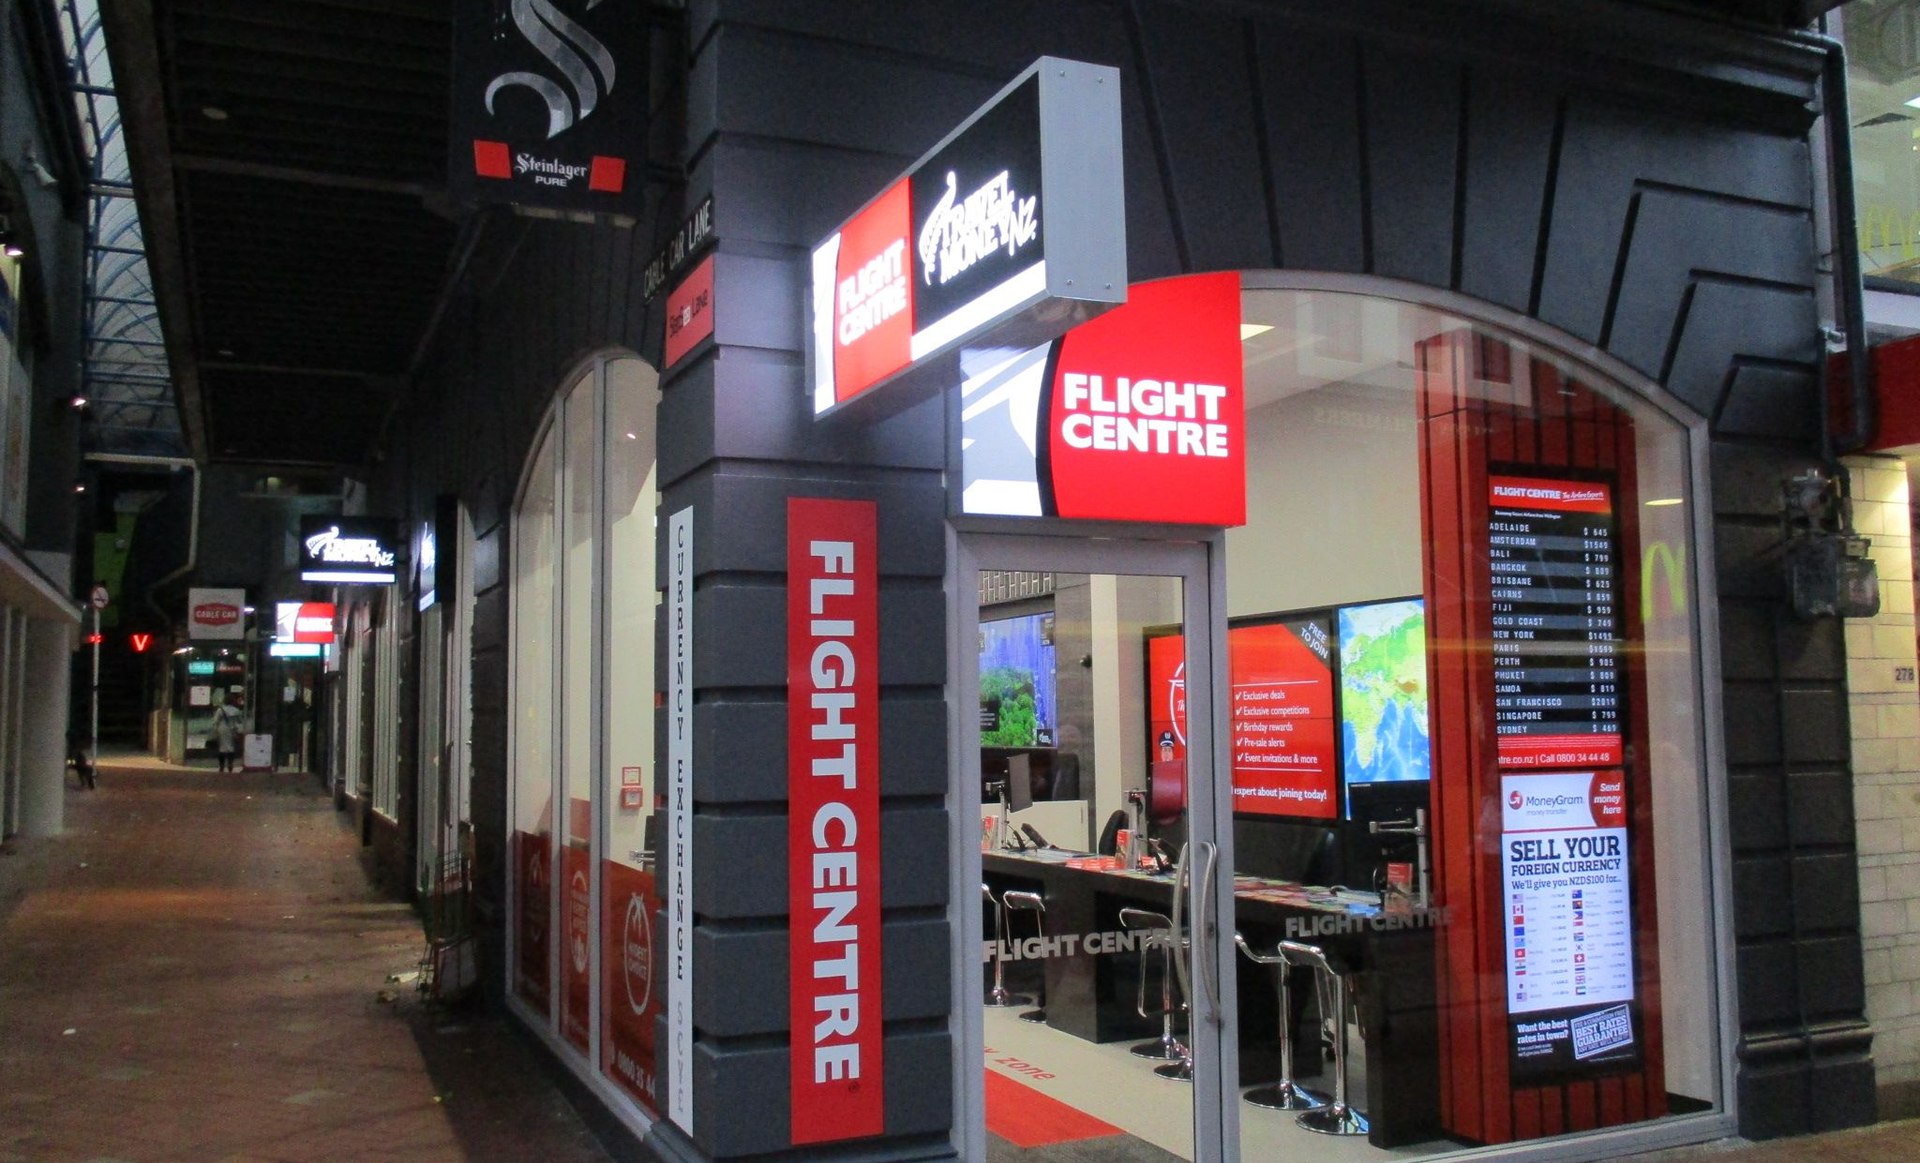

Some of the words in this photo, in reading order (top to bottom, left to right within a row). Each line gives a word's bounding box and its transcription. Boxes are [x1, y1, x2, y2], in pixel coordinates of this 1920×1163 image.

[515, 153, 587, 180] Steinlager
[535, 176, 567, 187] PURE
[644, 252, 666, 299] CABLE
[670, 230, 685, 270] CAR
[688, 199, 711, 251] LANE
[840, 238, 905, 315] FLIGHT
[839, 275, 906, 346] CENTRE
[1063, 373, 1226, 420] FLIGHT
[1061, 413, 1228, 457] CENTRE
[1494, 486, 1527, 497] FLIGHT
[1527, 489, 1561, 499] CENTRE
[1489, 522, 1529, 532] ADELAIDE
[1490, 536, 1536, 546] AMSTERDAM
[1490, 549, 1510, 558] BALI
[1490, 563, 1526, 572] BANGKOK
[1491, 577, 1532, 586] BRISBANE
[1491, 590, 1522, 599] CAIRNS
[1492, 603, 1512, 612] FIJI
[195, 610, 220, 618] CABLE
[1492, 617, 1513, 625] GOLD
[1518, 617, 1543, 626] COAST
[1308, 622, 1327, 644] FREE
[1514, 631, 1534, 639] YORK
[1301, 627, 1311, 642] TO
[1309, 638, 1329, 660] JOIN
[1493, 644, 1520, 652] PARIS
[810, 540, 856, 789] FLIGHT
[1494, 657, 1520, 666] PERTH
[1495, 671, 1525, 679] PHUKET
[1895, 668, 1914, 682] 278
[1495, 684, 1521, 693] SAMOA
[1243, 691, 1269, 700] Exclusive
[1270, 690, 1285, 699] deals
[1496, 698, 1511, 707] SAN
[1516, 698, 1562, 706] FRANCISCO
[1243, 706, 1269, 715] Exclusive
[1270, 705, 1310, 717] competitions
[1496, 711, 1542, 720] SINGAPORE
[1243, 722, 1268, 733] Birthday
[1268, 722, 1293, 731] rewards
[1497, 725, 1527, 734] SYDNEY
[1244, 738, 1267, 747] Pre-sale
[1268, 738, 1285, 747] alerts
[1245, 753, 1261, 762] Event
[1262, 754, 1292, 763] invitations
[1540, 755, 1555, 763] Call
[1556, 754, 1575, 763] 0800
[1576, 753, 1587, 762] 34
[1588, 753, 1598, 761] 44
[1600, 752, 1610, 761] 48
[1600, 782, 1620, 792] Send
[1258, 787, 1277, 797] about
[1278, 788, 1303, 801] joining
[1304, 789, 1327, 802] today!
[1594, 795, 1621, 805] money
[1526, 794, 1583, 808] MoneyGram
[1603, 806, 1621, 814] here
[1510, 838, 1561, 862] SELL
[1564, 835, 1620, 859] YOUR
[676, 759, 684, 980] EXCHANGE
[1511, 862, 1560, 877] FOREIGN
[1562, 858, 1621, 873] CURRENCY
[1511, 880, 1533, 890] We'll
[1533, 879, 1551, 891] give
[1552, 879, 1568, 889] you
[1285, 912, 1366, 938] FLIGHT
[1370, 906, 1453, 932] CENTRE
[812, 801, 860, 1084] CENTRE
[983, 934, 1079, 962] FLIGHT
[1517, 1022, 1537, 1033] Want
[1538, 1020, 1551, 1031] the
[1551, 1019, 1568, 1030] best
[1575, 1023, 1597, 1037] BEST
[1599, 1015, 1626, 1031] RATES
[1517, 1033, 1537, 1044] rates
[1537, 1032, 1546, 1041] in
[1546, 1029, 1569, 1040] town?
[1577, 1025, 1628, 1047] GUARANTEE
[995, 1057, 1057, 1081] zone
